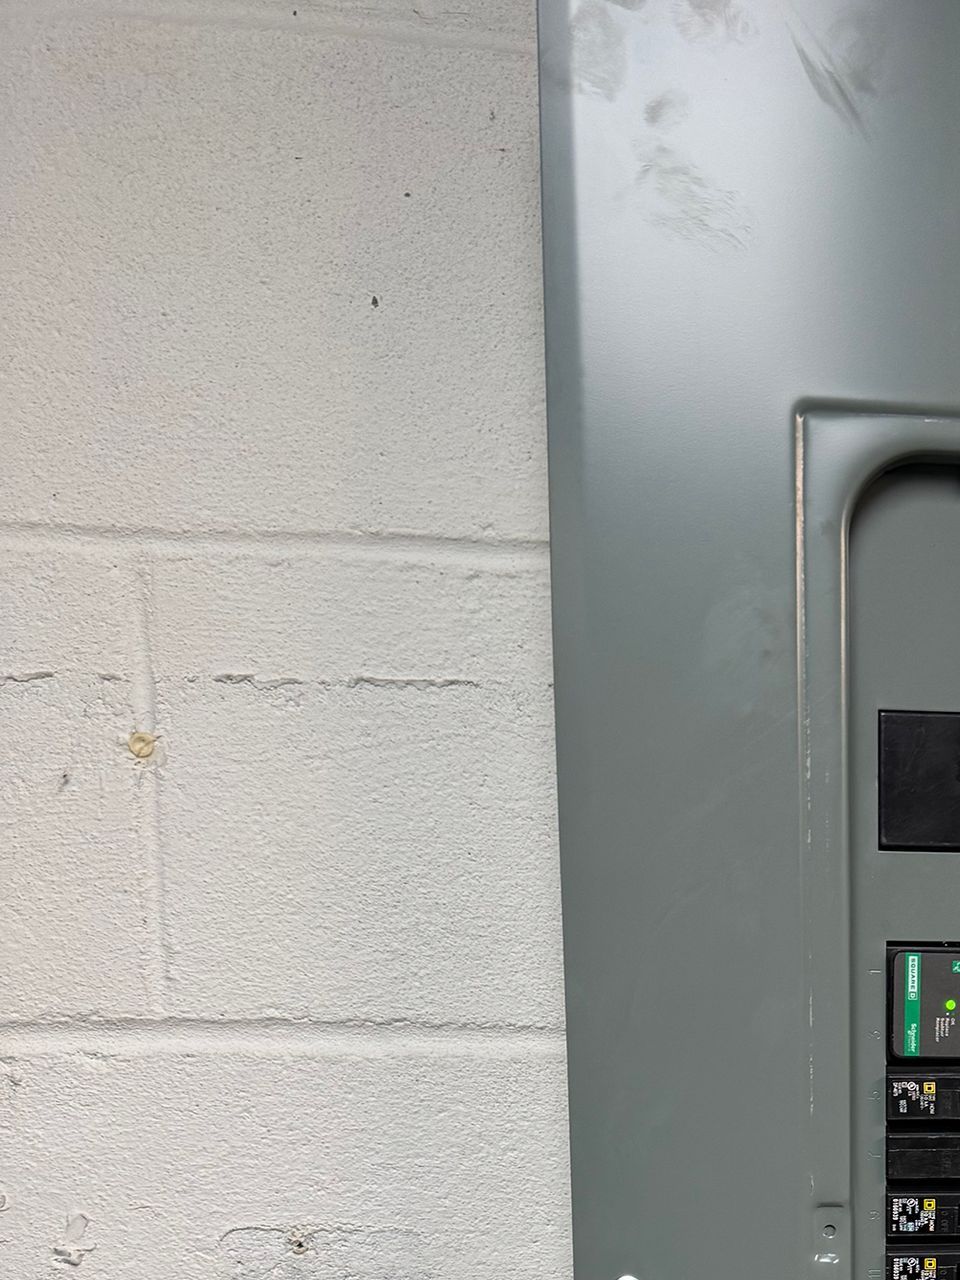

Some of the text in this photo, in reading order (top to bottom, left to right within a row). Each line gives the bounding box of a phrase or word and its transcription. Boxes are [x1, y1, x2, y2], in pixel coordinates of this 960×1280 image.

[910, 957, 918, 990] SQUARE
[950, 1018, 956, 1026] OK
[908, 1023, 917, 1053] Schneider
